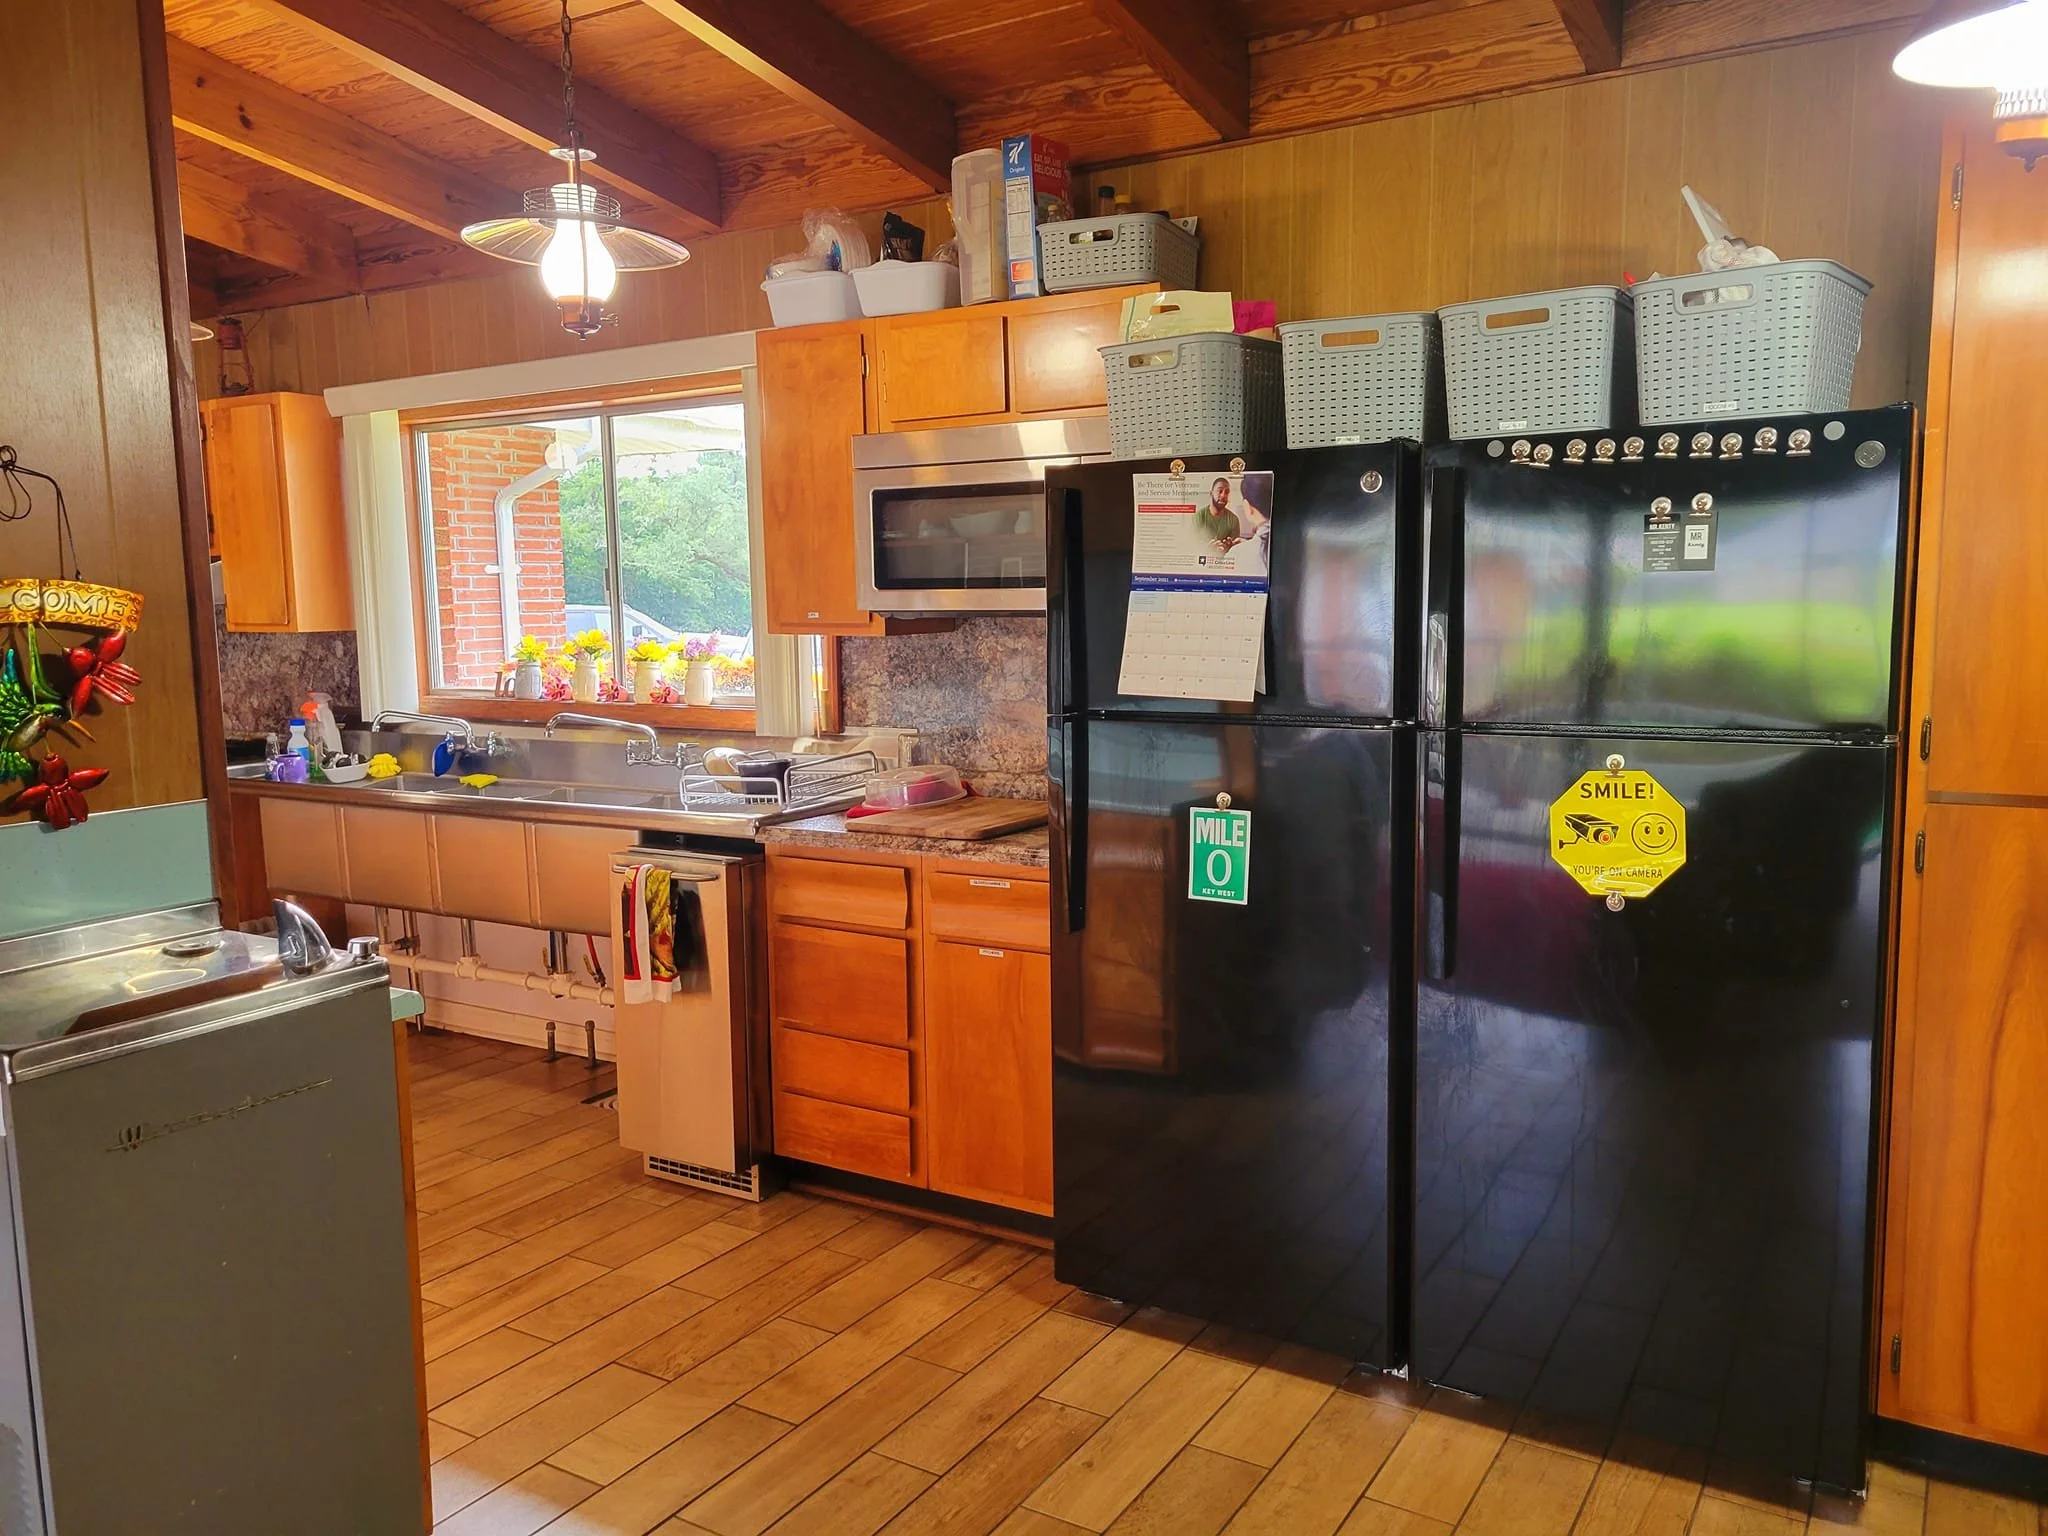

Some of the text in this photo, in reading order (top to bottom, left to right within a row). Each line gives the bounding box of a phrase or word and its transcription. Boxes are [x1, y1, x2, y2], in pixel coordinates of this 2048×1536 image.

[0, 587, 128, 622] COME
[1580, 782, 1655, 799] SMILE!
[1196, 817, 1245, 847] MILE
[1206, 849, 1232, 886] 0
[1573, 864, 1663, 879] YOU'RE ON CAMERA
[1202, 887, 1235, 897] KEY WEST
